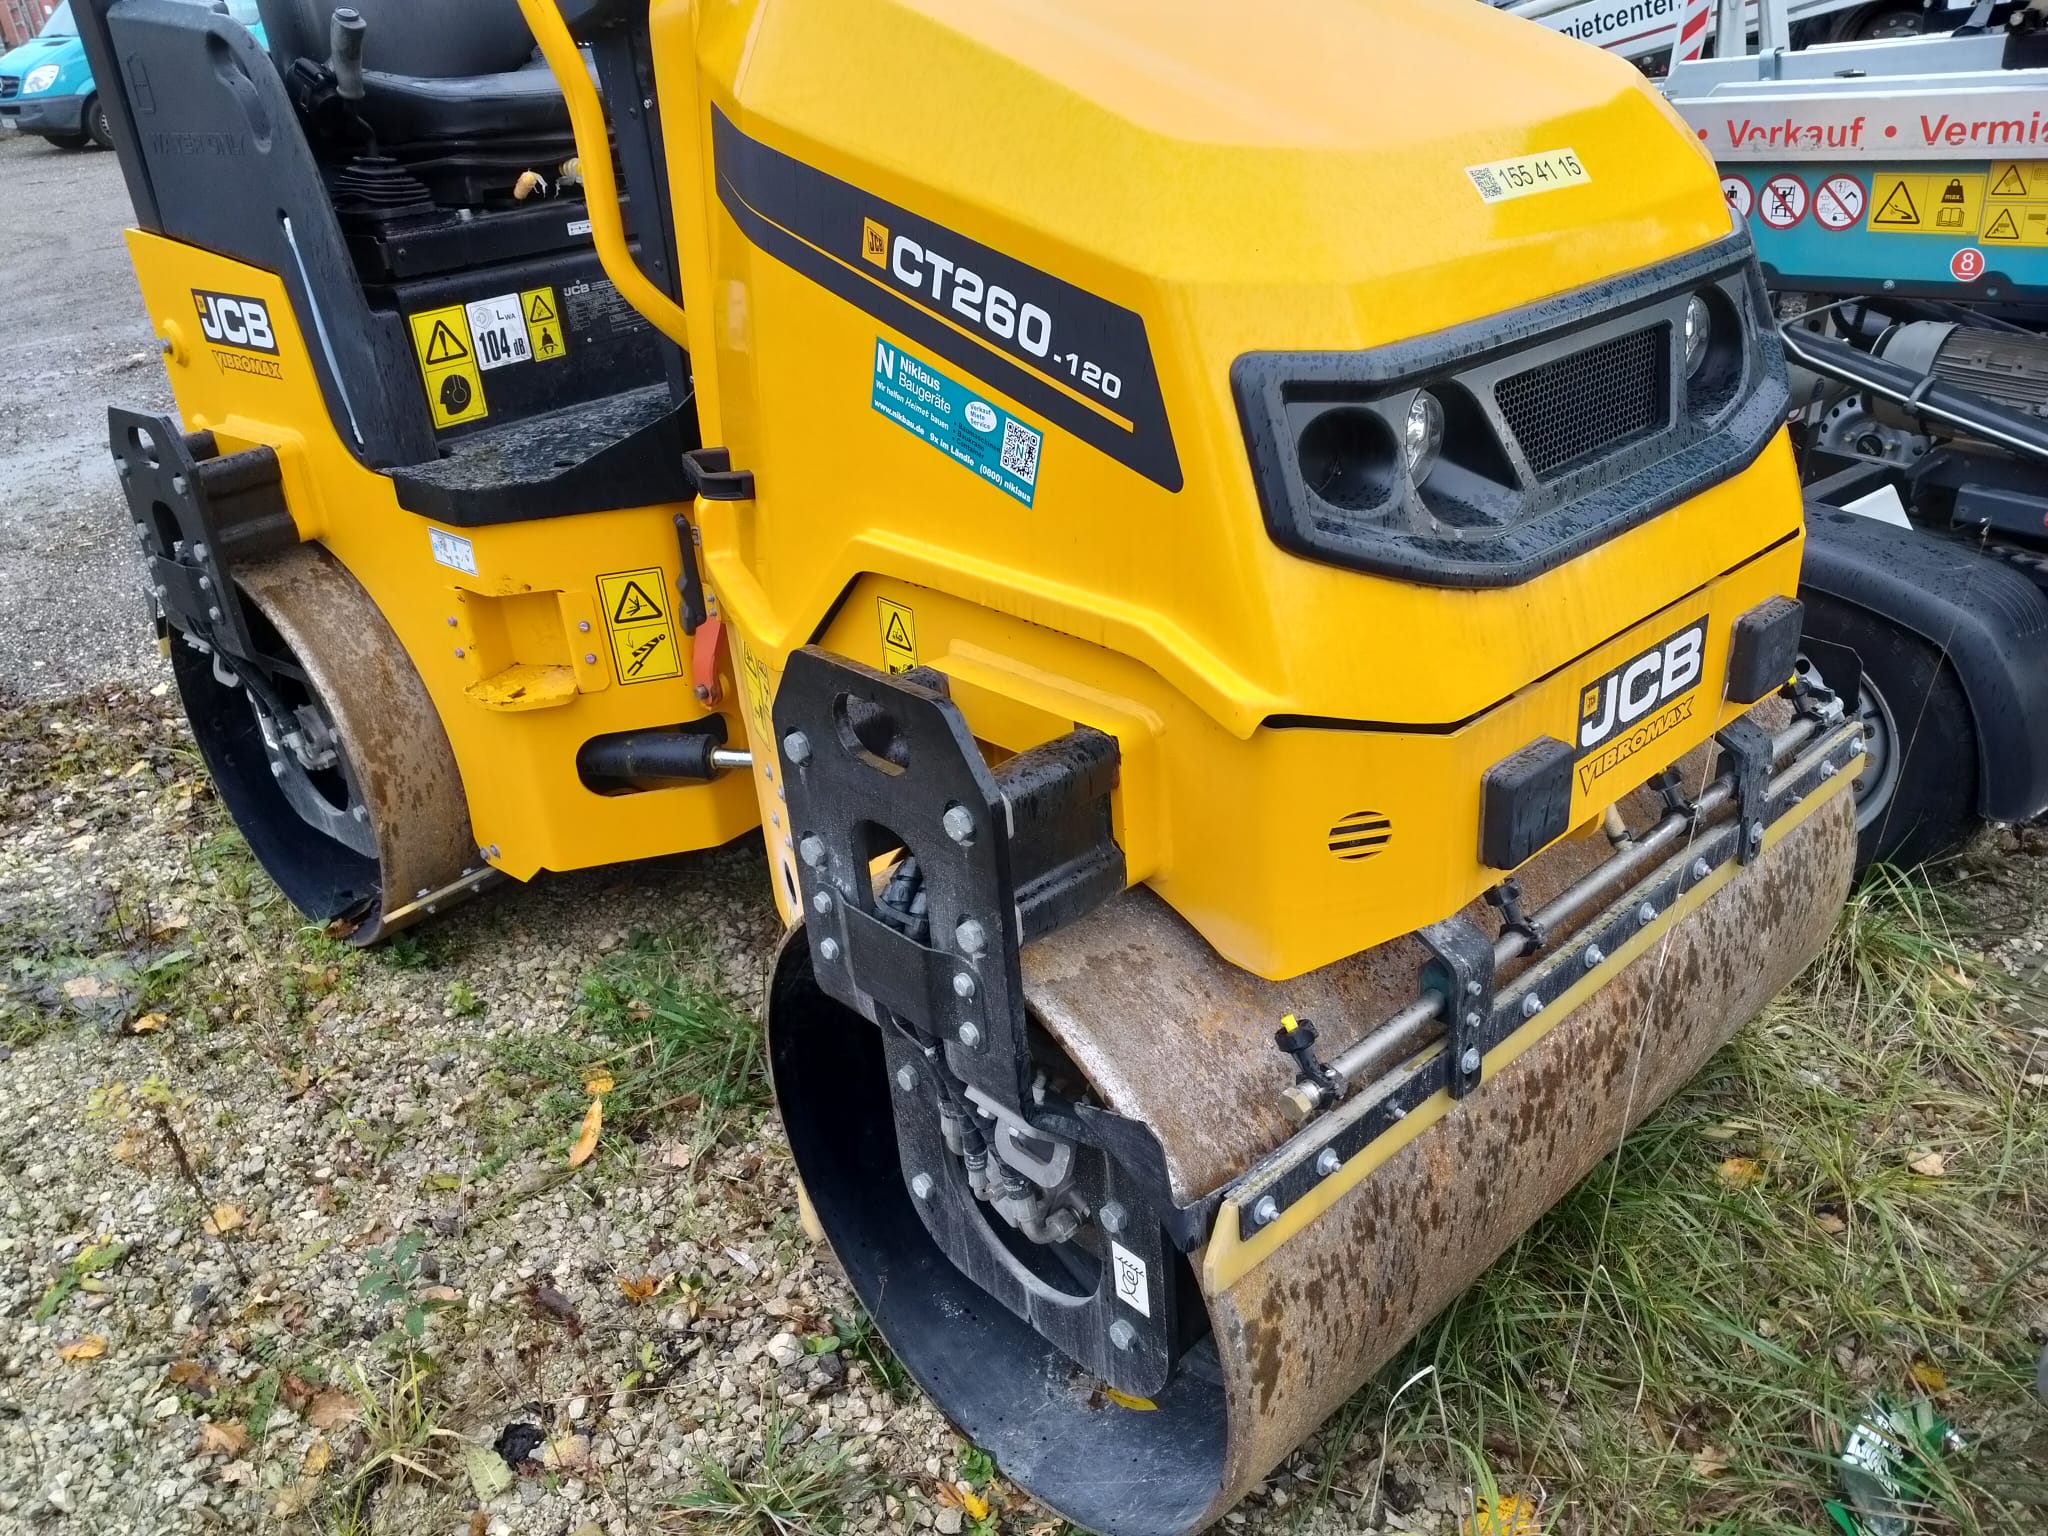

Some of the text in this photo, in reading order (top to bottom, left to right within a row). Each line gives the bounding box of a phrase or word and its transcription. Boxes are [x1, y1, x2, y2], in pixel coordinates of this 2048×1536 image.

[1727, 116, 1866, 148] Verkauf
[1499, 156, 1582, 189] 155 41 15
[1961, 252, 1975, 272] 8
[563, 284, 590, 297] JCB
[201, 296, 274, 349] JCB
[478, 327, 526, 363] 104 dB
[876, 342, 895, 380] N
[211, 349, 283, 380] VIBROMAX
[900, 355, 941, 392] Niklaus
[899, 371, 951, 414] Baugeräte
[930, 413, 949, 431] bauen
[1004, 479, 1031, 503] niklaus
[1580, 627, 1703, 748] JCB
[1578, 695, 1695, 796] VIBROMAX
